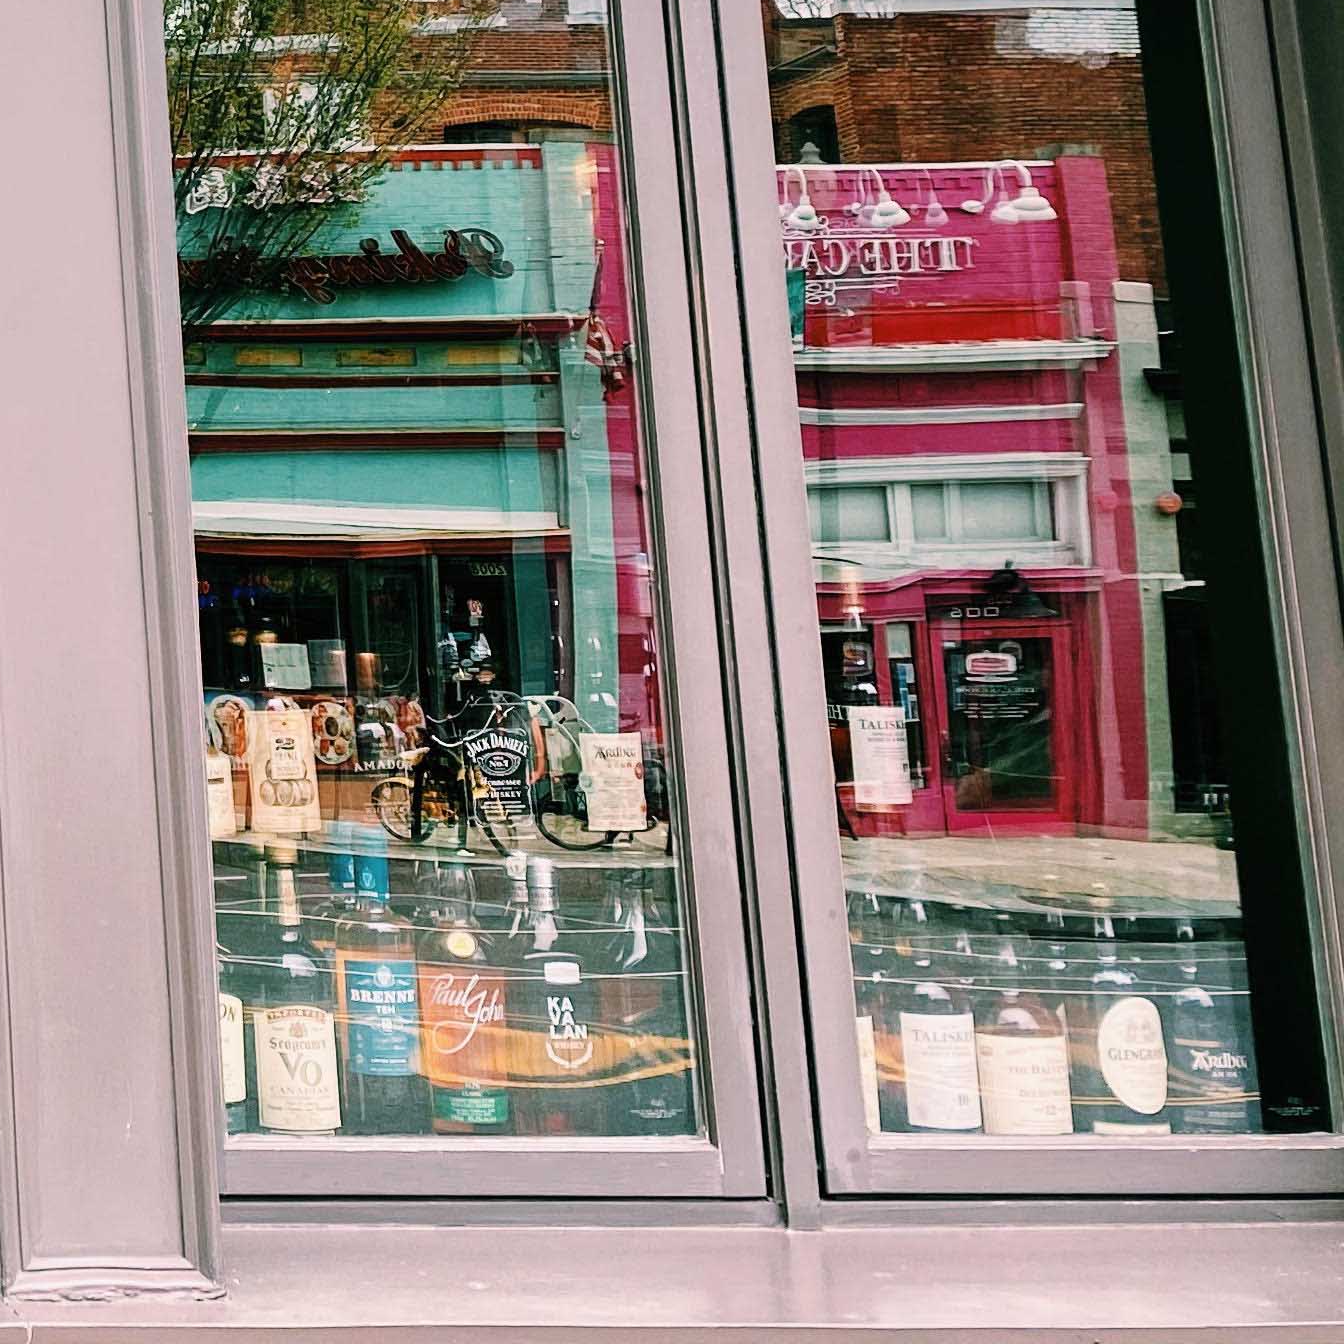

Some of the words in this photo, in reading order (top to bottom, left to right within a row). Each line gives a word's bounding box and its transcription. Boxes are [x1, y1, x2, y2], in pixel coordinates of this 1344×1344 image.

[466, 736, 491, 758] JACK
[490, 733, 529, 757] DANIEL'S
[549, 1024, 588, 1039] LAN
